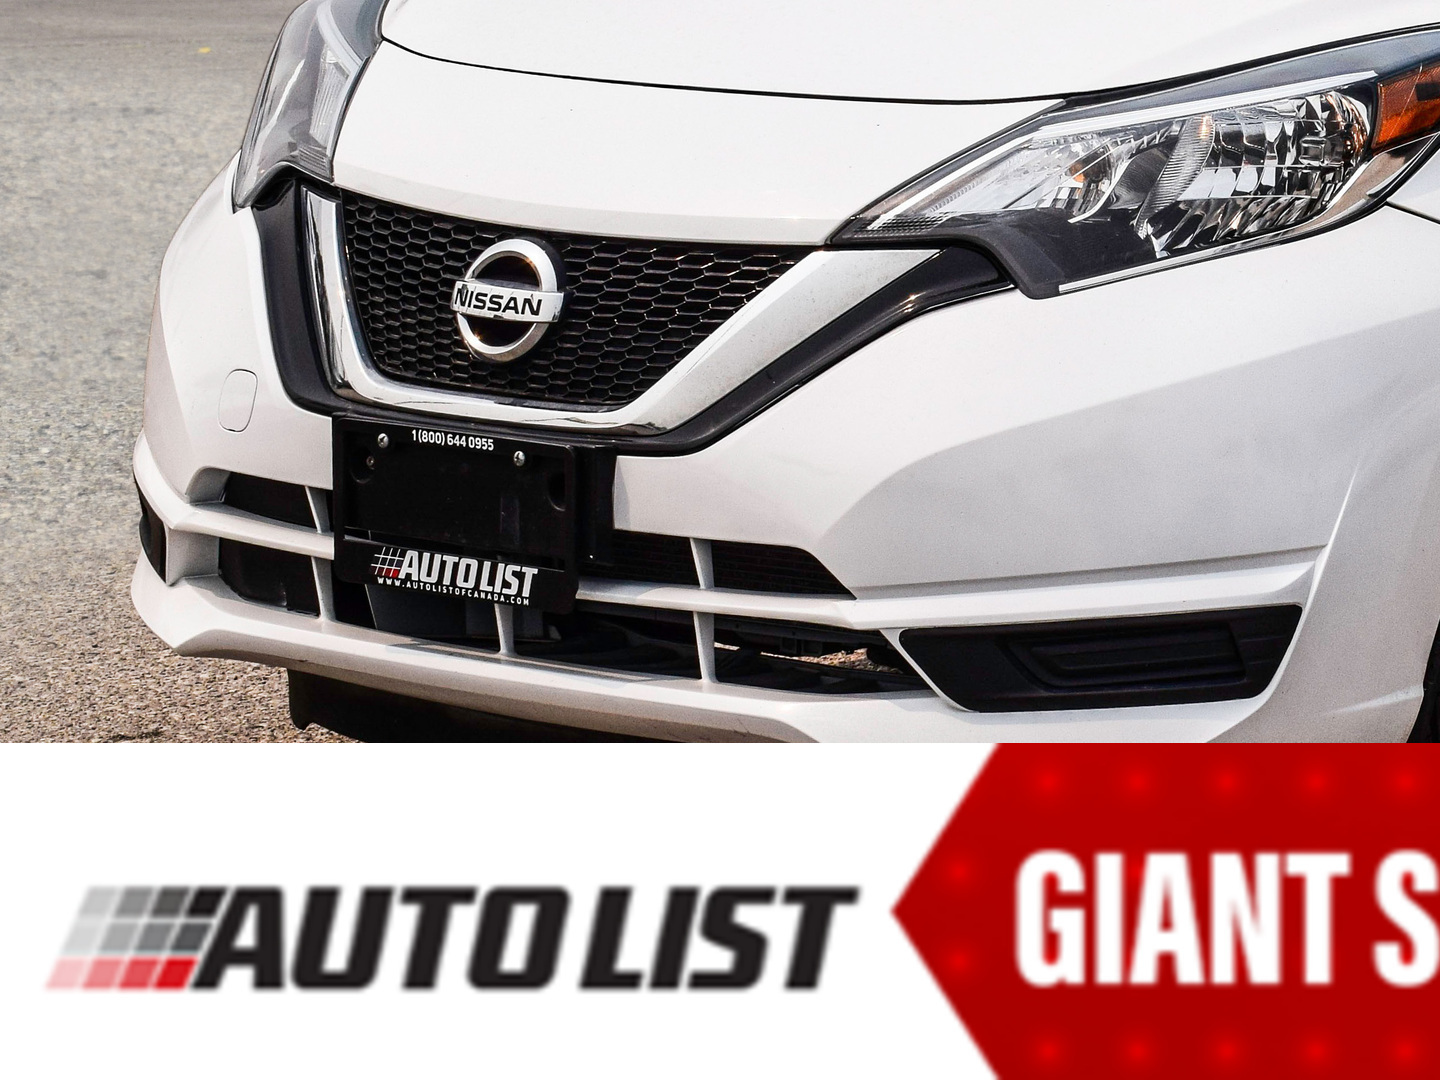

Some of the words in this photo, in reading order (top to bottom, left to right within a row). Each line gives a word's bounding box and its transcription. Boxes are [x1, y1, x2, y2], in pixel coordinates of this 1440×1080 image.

[453, 286, 543, 317] NISSAN
[447, 434, 467, 448] 644
[468, 437, 495, 451] 0955
[398, 550, 478, 589] AUTO
[479, 560, 539, 598] LIST
[377, 576, 530, 606] WWW.AUTOLISTOFCANADA.COM
